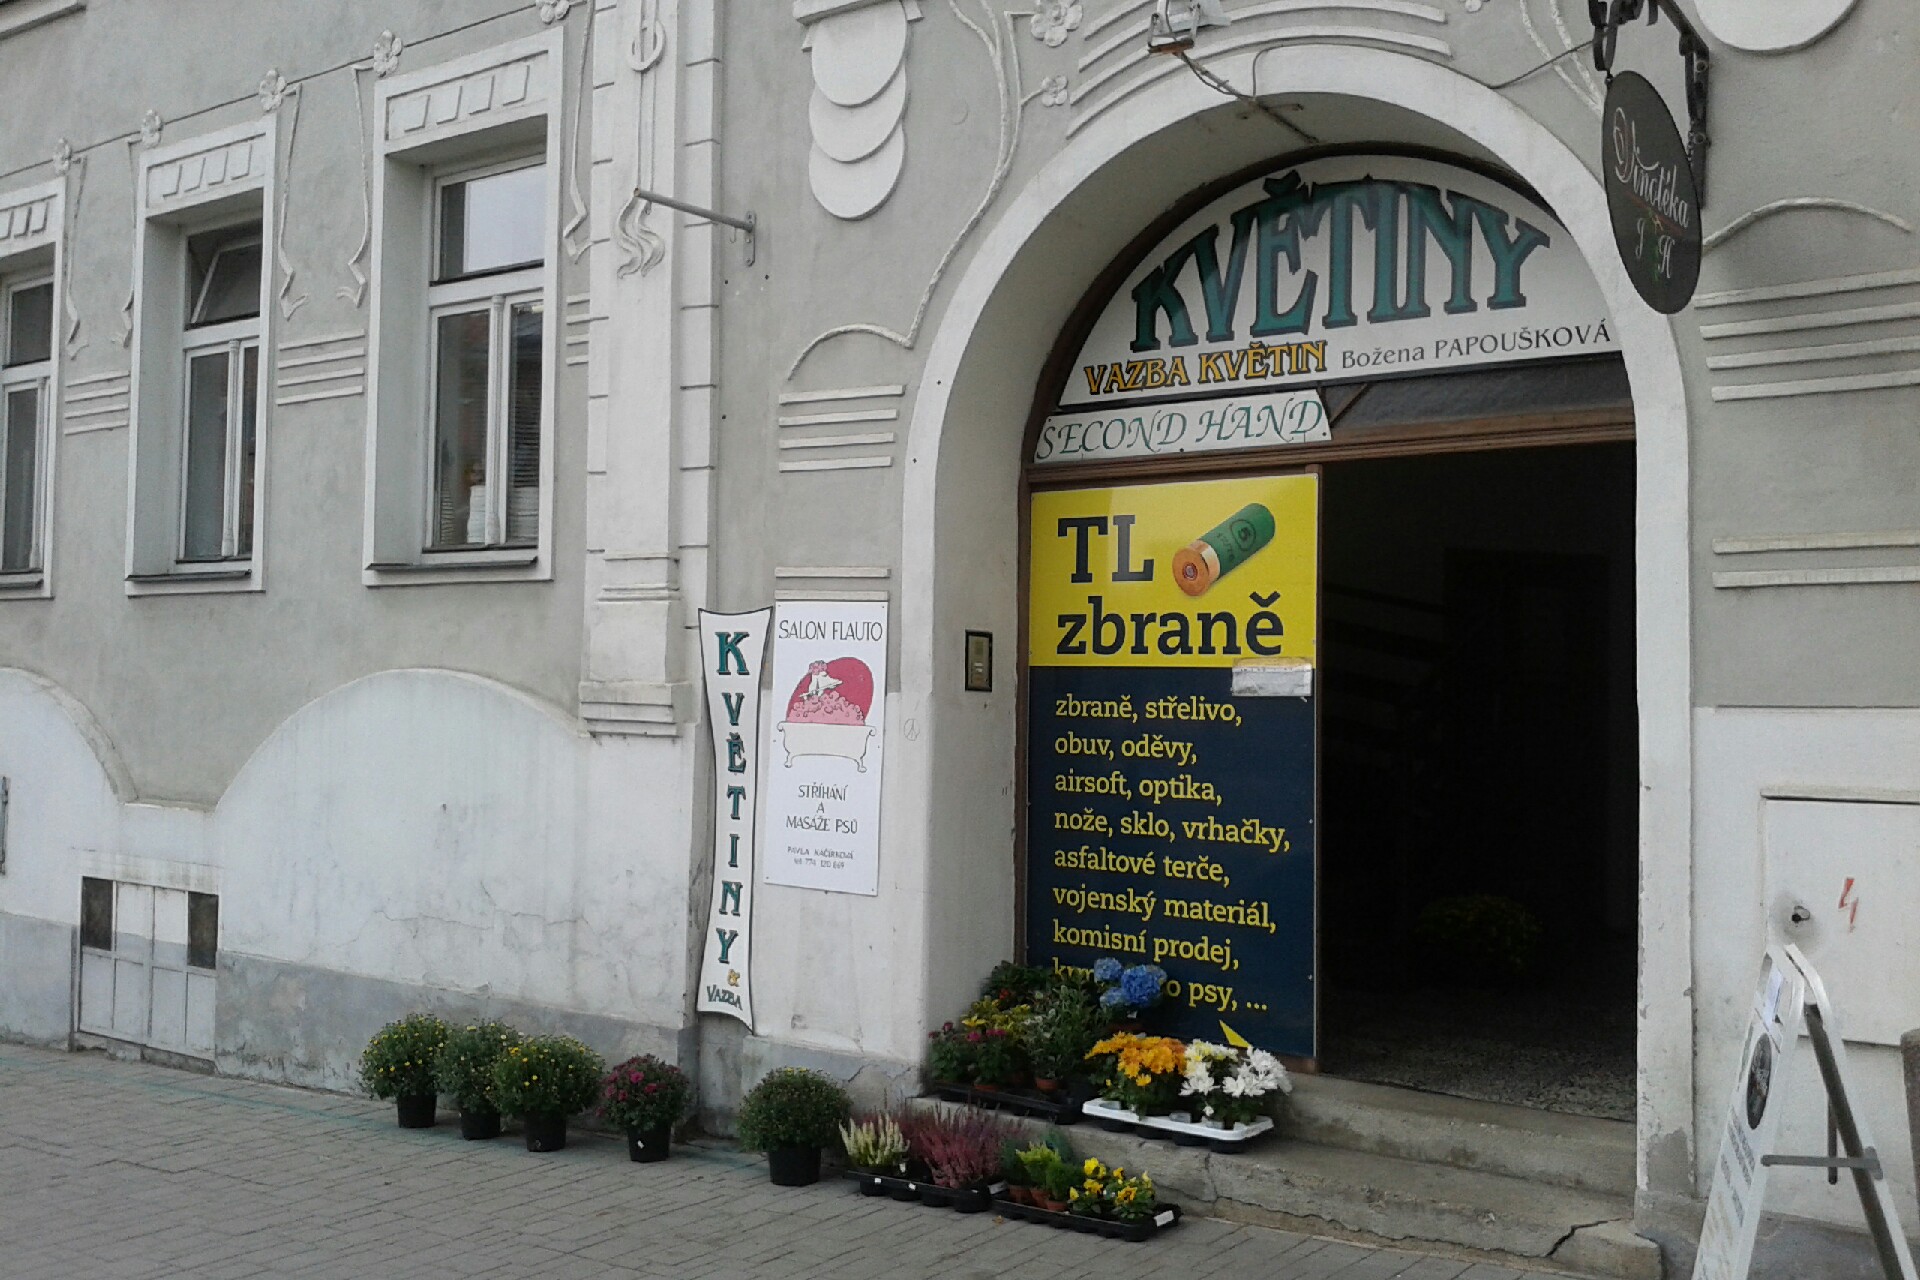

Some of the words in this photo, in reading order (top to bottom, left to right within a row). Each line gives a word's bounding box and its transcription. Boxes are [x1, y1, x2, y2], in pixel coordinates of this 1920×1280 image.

[1130, 169, 1550, 354] KVĚTINY
[1342, 346, 1425, 369] Božena
[1434, 317, 1611, 359] PAPOUŠKOVÁ
[1083, 355, 1192, 395] VAZBA
[1198, 339, 1327, 384] KVĚTIN
[1036, 409, 1187, 460] SECOND
[1195, 397, 1322, 443] HAND
[1057, 514, 1154, 583] TL
[778, 619, 826, 641] SALON
[832, 620, 883, 642] FLAUTO
[1056, 591, 1284, 656] zbraně
[1055, 693, 1138, 723] zbraně,
[1145, 695, 1242, 726] střelivo,
[1055, 731, 1114, 761] obuv,
[1121, 733, 1197, 766] oděvy,
[714, 631, 750, 964] KVĚTINY
[798, 782, 848, 801] STŘÍHÁNÍ
[816, 801, 825, 814] A
[1055, 768, 1132, 801] airsoft,
[1138, 774, 1222, 807] optika,
[786, 815, 831, 832] MASÁŽE
[1054, 807, 1113, 838] nože,
[1120, 810, 1176, 843] sklo,
[1182, 816, 1290, 853] vrhačky,
[1054, 846, 1156, 875] asfaltové
[1163, 854, 1230, 888] terče,
[1053, 883, 1157, 921] vojenský
[1163, 899, 1277, 934] materiál,
[1053, 919, 1147, 953] komisní
[1153, 935, 1239, 971] prodej,
[1188, 981, 1238, 1012] psy,
